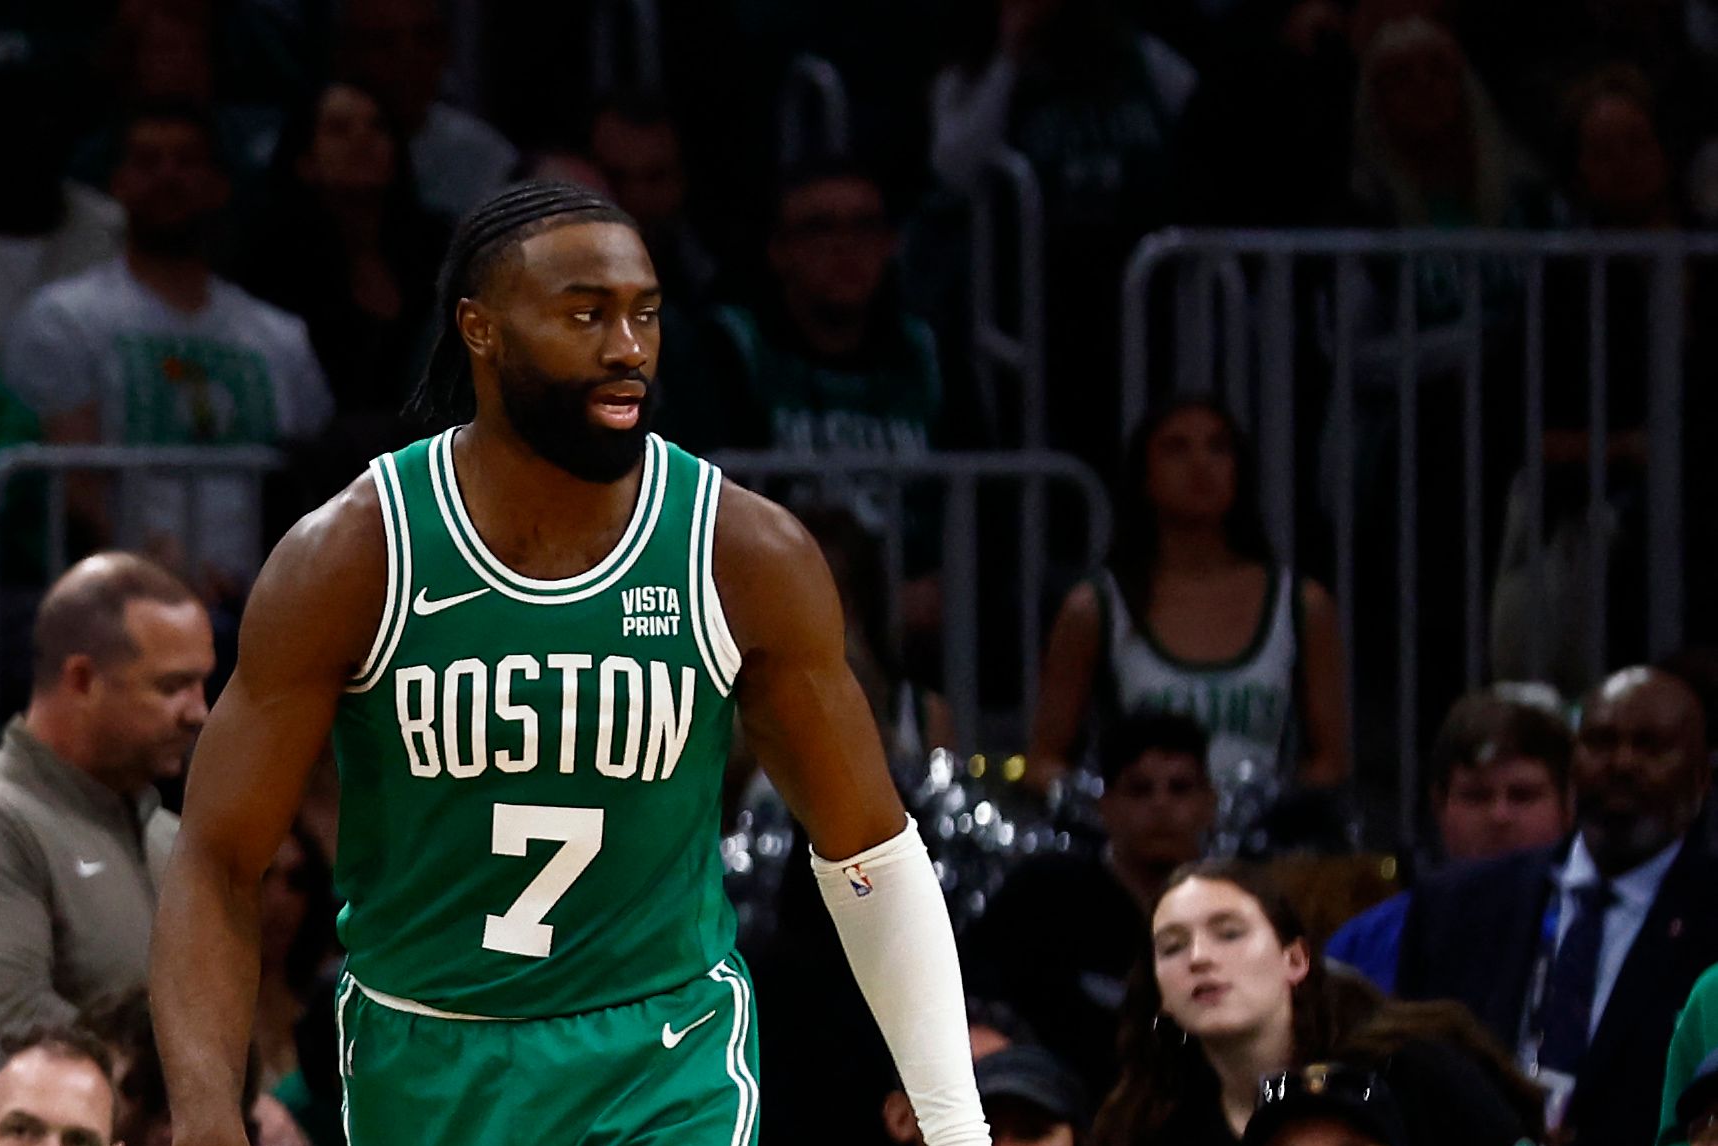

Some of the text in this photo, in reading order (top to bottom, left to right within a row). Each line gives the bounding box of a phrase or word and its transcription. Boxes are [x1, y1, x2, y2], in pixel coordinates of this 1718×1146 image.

[621, 586, 680, 615] VISTA
[623, 615, 680, 637] PRINT
[395, 653, 696, 781] BOSTON
[482, 803, 604, 958] 7
